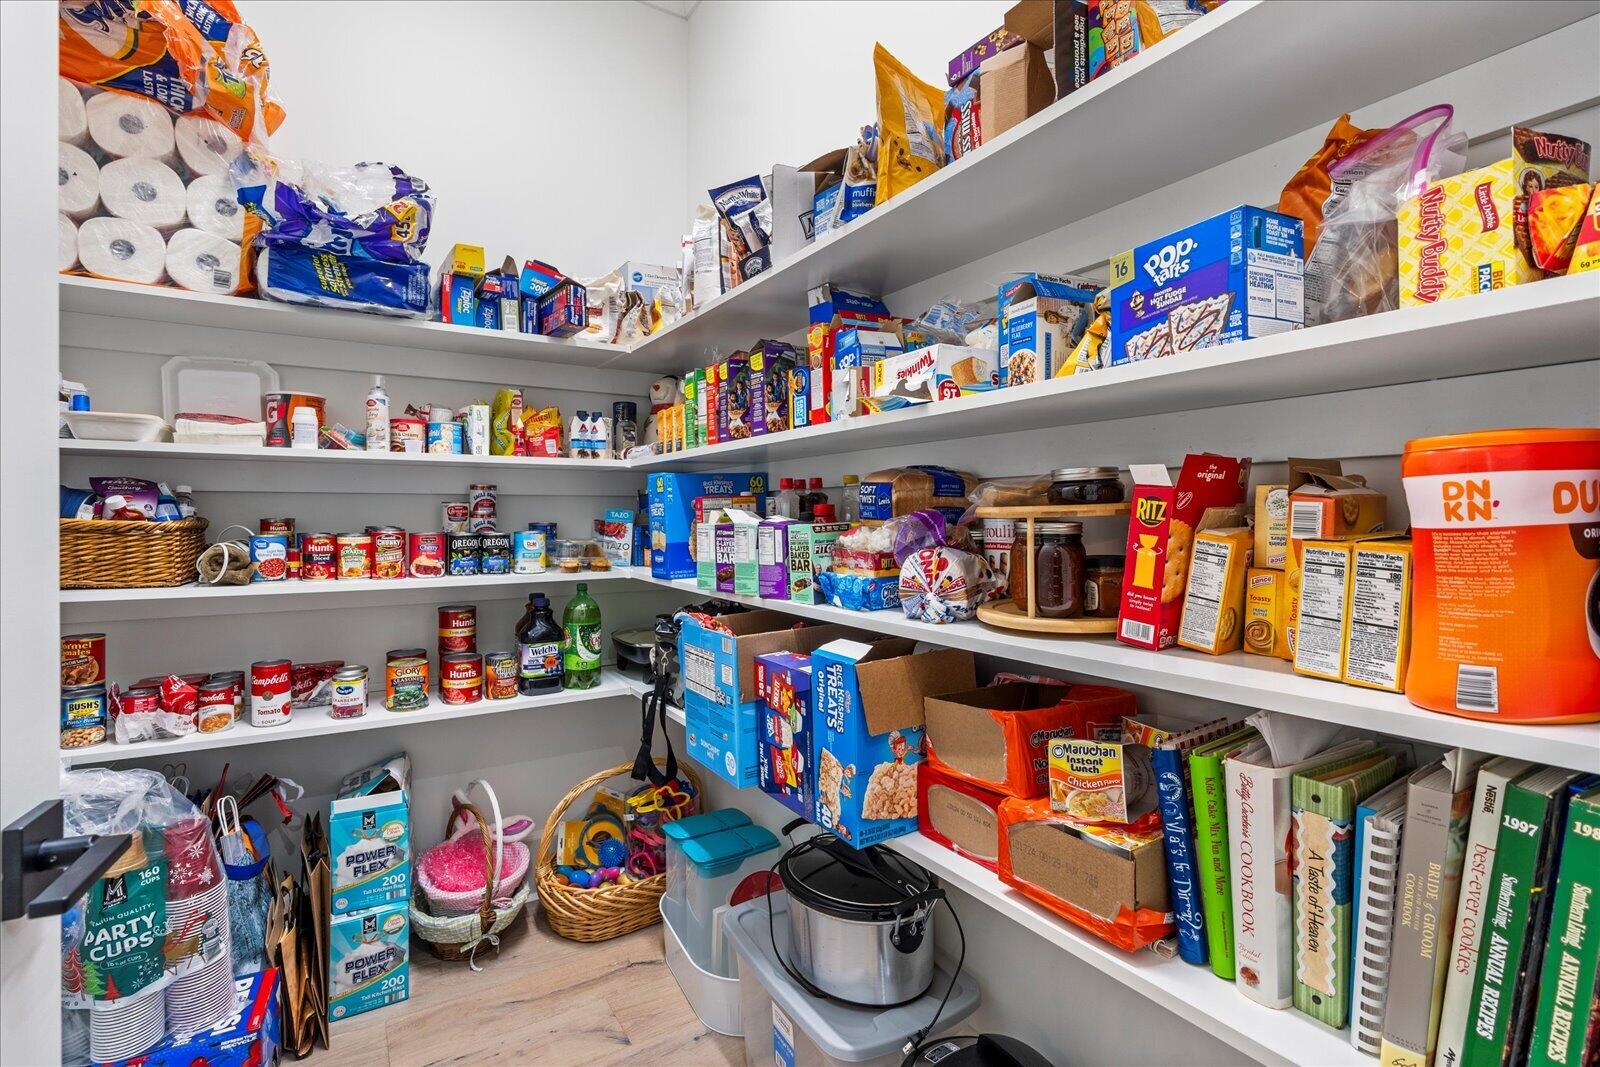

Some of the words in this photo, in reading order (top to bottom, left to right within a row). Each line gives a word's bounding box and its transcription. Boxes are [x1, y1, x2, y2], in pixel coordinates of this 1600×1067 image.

[1078, 16, 1086, 68] ingredients
[1534, 136, 1575, 169] Nutty
[1415, 185, 1447, 243] Nutty
[1115, 261, 1128, 278] 16
[1414, 240, 1448, 304] Buddy
[1249, 281, 1274, 291] HEATING
[1492, 270, 1504, 289] BIG
[462, 288, 473, 314] Ziploc
[1150, 296, 1164, 306] HOT
[1165, 286, 1187, 300] FUDGE
[1156, 295, 1183, 309] SUNDAE
[1011, 321, 1034, 334] BLUEBERRY
[1011, 332, 1022, 340] FLAX
[897, 350, 935, 380] Twinkies
[750, 476, 763, 487] 60
[1197, 470, 1226, 482] original
[704, 486, 733, 494] TREATS
[860, 485, 876, 494] SOFT
[1442, 479, 1490, 501] DN
[1553, 480, 1600, 514] DU
[860, 494, 876, 504] TWIST
[610, 511, 629, 519] TAZO
[1136, 497, 1167, 521] RITZ
[452, 538, 479, 550] OREGON
[482, 538, 510, 549] OREGON
[606, 542, 630, 551] TAZO
[1196, 541, 1216, 550] Nutrition
[716, 553, 735, 564] BAR
[1358, 551, 1384, 560] Nutrition
[791, 560, 811, 571] BAR
[1305, 566, 1322, 574] Calories
[1334, 568, 1345, 576] 180
[1357, 570, 1376, 578] Calories
[1251, 576, 1272, 587] Lance
[1250, 594, 1272, 603] Toasty
[1290, 597, 1299, 623] Toasty
[63, 641, 92, 651] ormel
[530, 645, 557, 657] Welch's
[395, 667, 421, 676] GLORY
[826, 664, 838, 729] TREATS
[69, 700, 99, 712] BUSH'S
[257, 706, 281, 716] Tomato
[837, 688, 845, 734] KRISPIES
[1038, 726, 1074, 739] Maruchan
[1063, 743, 1117, 757] Maruchan
[1067, 755, 1103, 766] Instant
[1071, 764, 1100, 774] Lunch
[1067, 776, 1103, 789] Chicken
[1205, 777, 1216, 798] Kids'
[1236, 772, 1253, 801] Betty
[820, 801, 833, 829] 40
[1207, 799, 1218, 819] Cake
[1211, 822, 1221, 839] Mix
[1503, 815, 1539, 838] 1997
[1212, 840, 1222, 855] Fun
[1309, 848, 1325, 860] A
[346, 845, 397, 868] POWER
[1213, 856, 1223, 871] and
[139, 866, 160, 879] 160
[353, 858, 390, 878] FLEX
[141, 875, 160, 886] CUPS
[382, 873, 406, 887] 200
[1215, 873, 1226, 896] More
[1309, 865, 1325, 893] Taste
[1427, 861, 1442, 900] BRIDE
[1467, 843, 1497, 917] best-ever
[373, 885, 392, 894] Kitchen
[1240, 839, 1255, 938] COOKBOOK
[1309, 896, 1324, 914] of
[1402, 873, 1416, 929] COOKBOOK
[1570, 882, 1593, 919] Southern
[84, 911, 157, 946] PARTY
[1310, 914, 1325, 953] Heaven
[1421, 913, 1437, 960] GROOM
[89, 931, 154, 962] CUPS
[1238, 943, 1261, 959] Bridal
[1456, 915, 1481, 976] cookies
[345, 948, 396, 972] POWER
[1490, 931, 1509, 985] ANNUAL
[352, 964, 390, 985] FLEX
[381, 974, 405, 990] 200
[1560, 951, 1581, 1004] ANNUAL
[1476, 982, 1501, 1041] RECIPES
[1548, 1001, 1574, 1065] RECIPES
